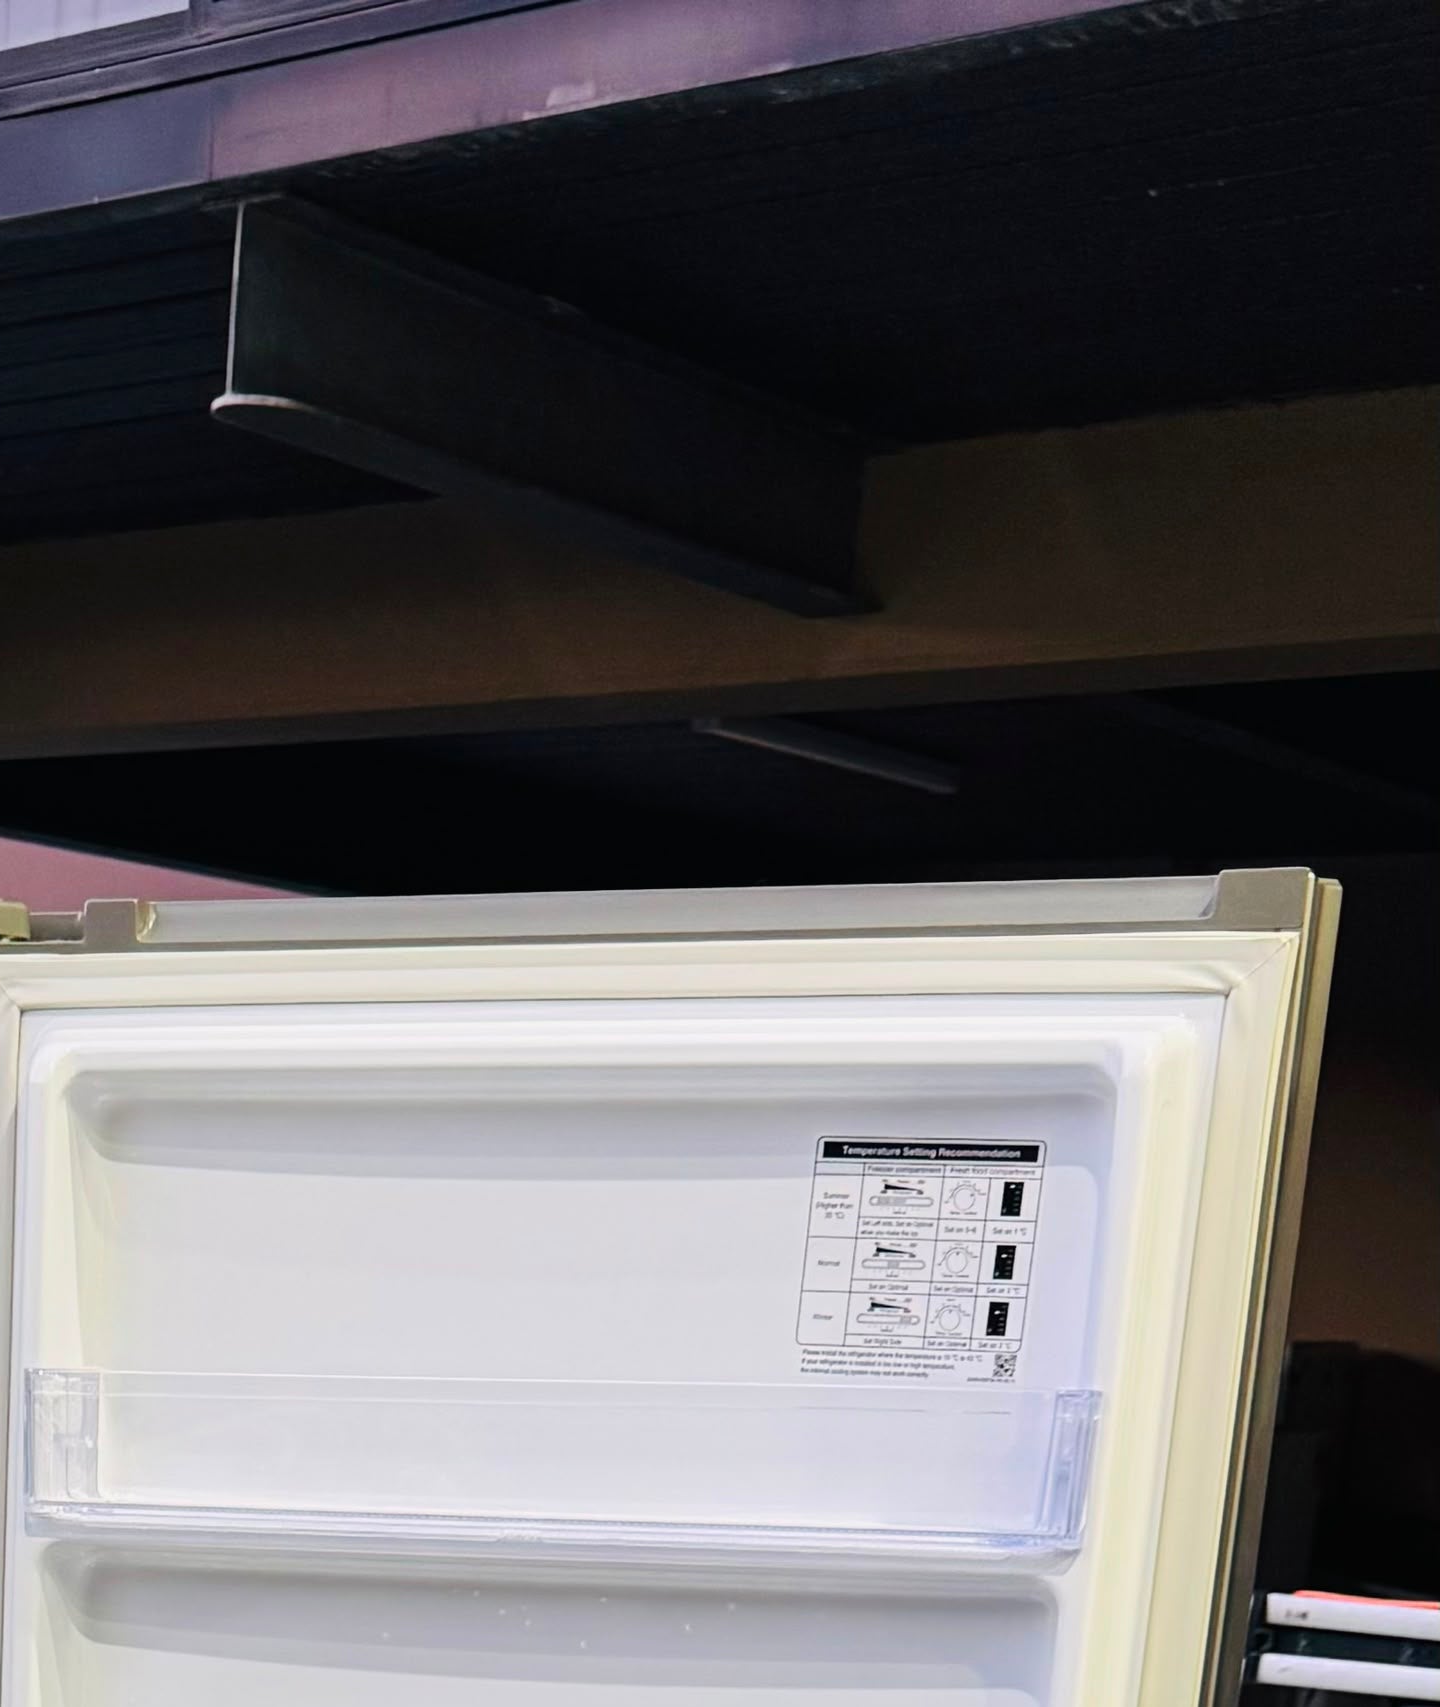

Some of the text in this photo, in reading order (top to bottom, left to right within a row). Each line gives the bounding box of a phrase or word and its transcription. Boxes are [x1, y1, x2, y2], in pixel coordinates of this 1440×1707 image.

[842, 1145, 1021, 1159] Temperature Setting Recommendation
